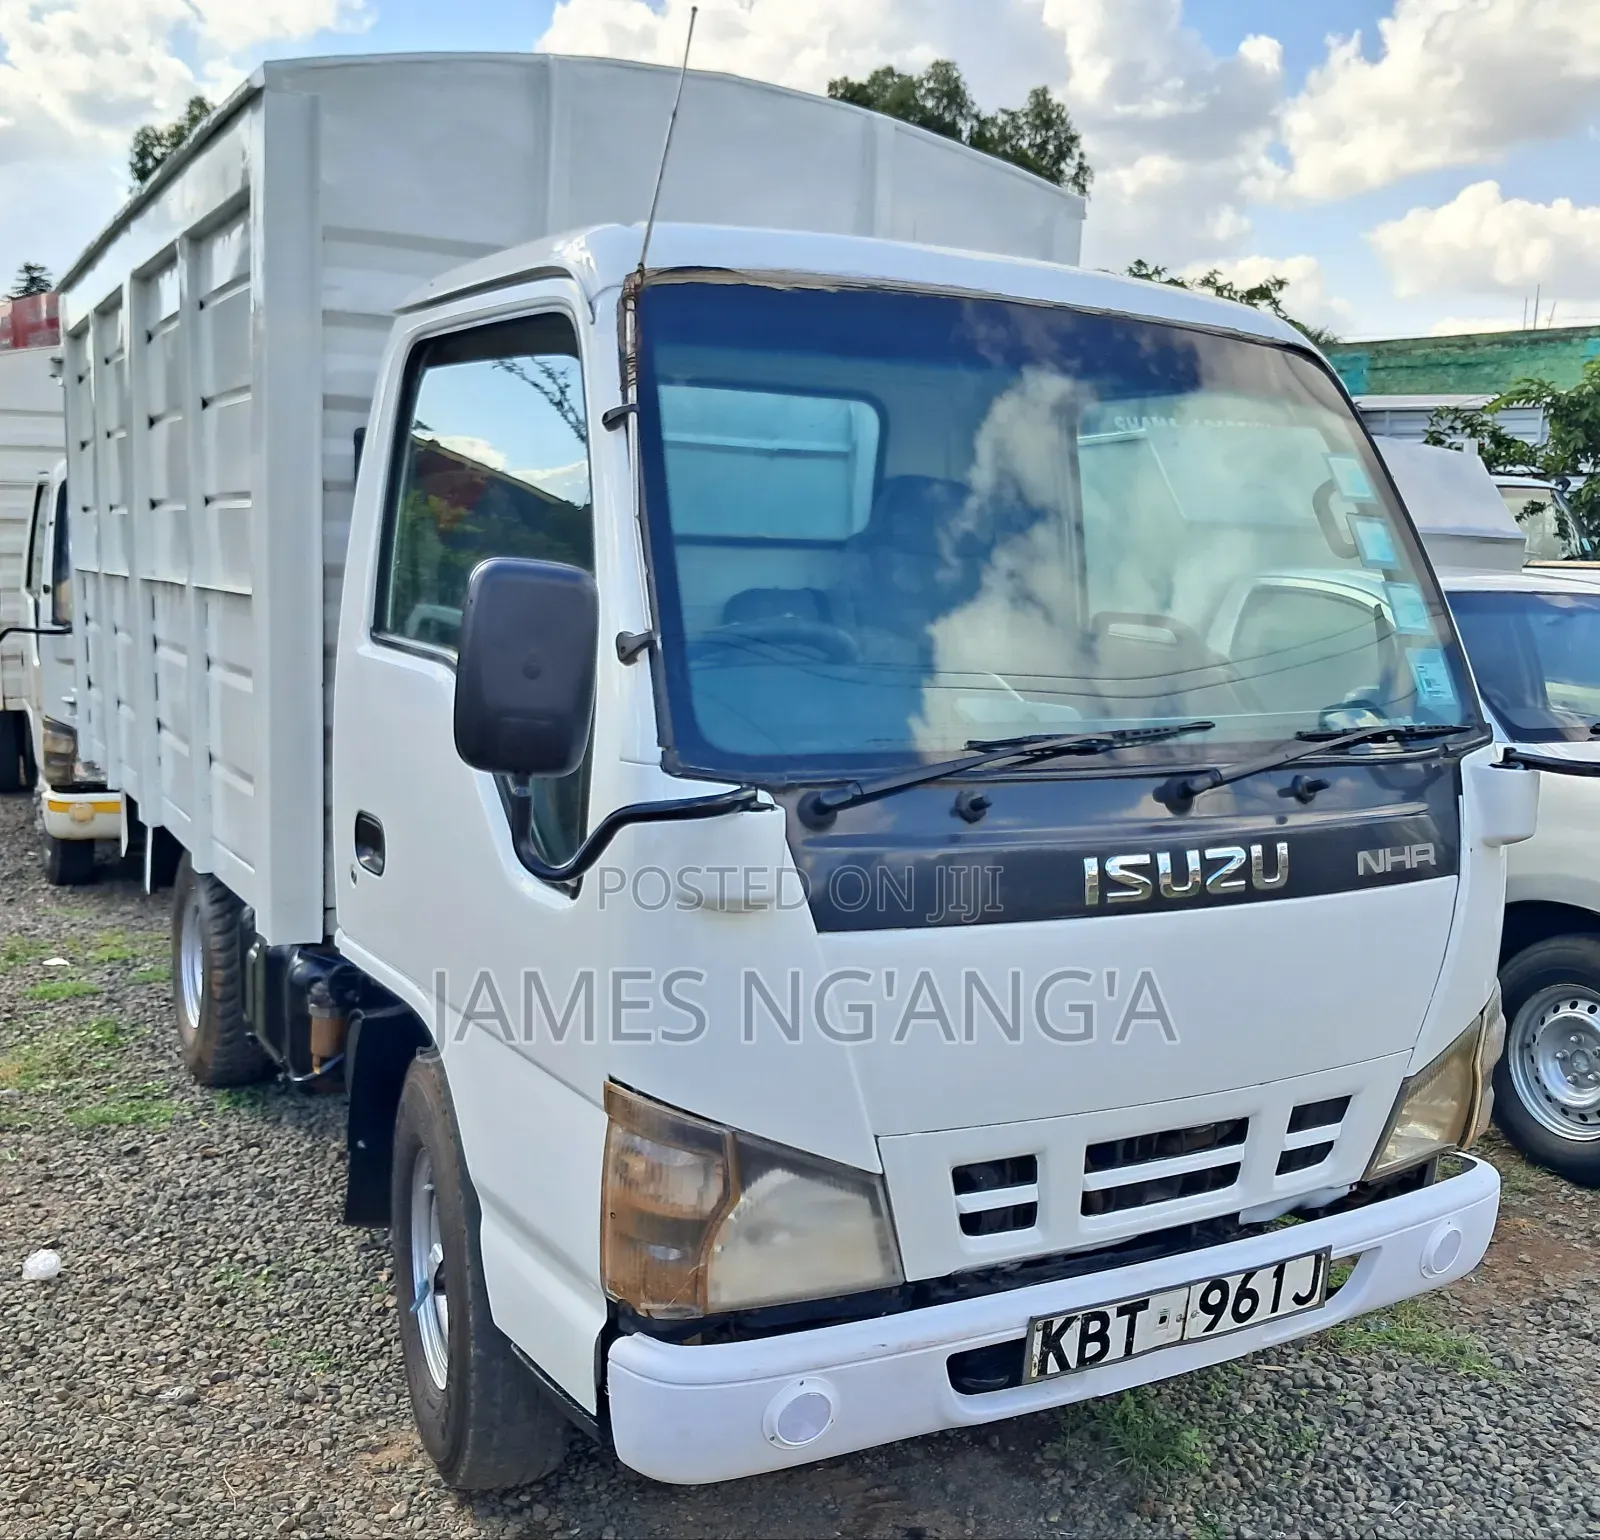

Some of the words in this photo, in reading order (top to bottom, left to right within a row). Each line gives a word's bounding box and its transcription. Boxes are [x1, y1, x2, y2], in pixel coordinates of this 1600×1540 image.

[1083, 842, 1290, 906] ISUZU
[1356, 842, 1437, 877] NHR
[1038, 1298, 1150, 1377] KBT
[1199, 1253, 1322, 1333] 961J
